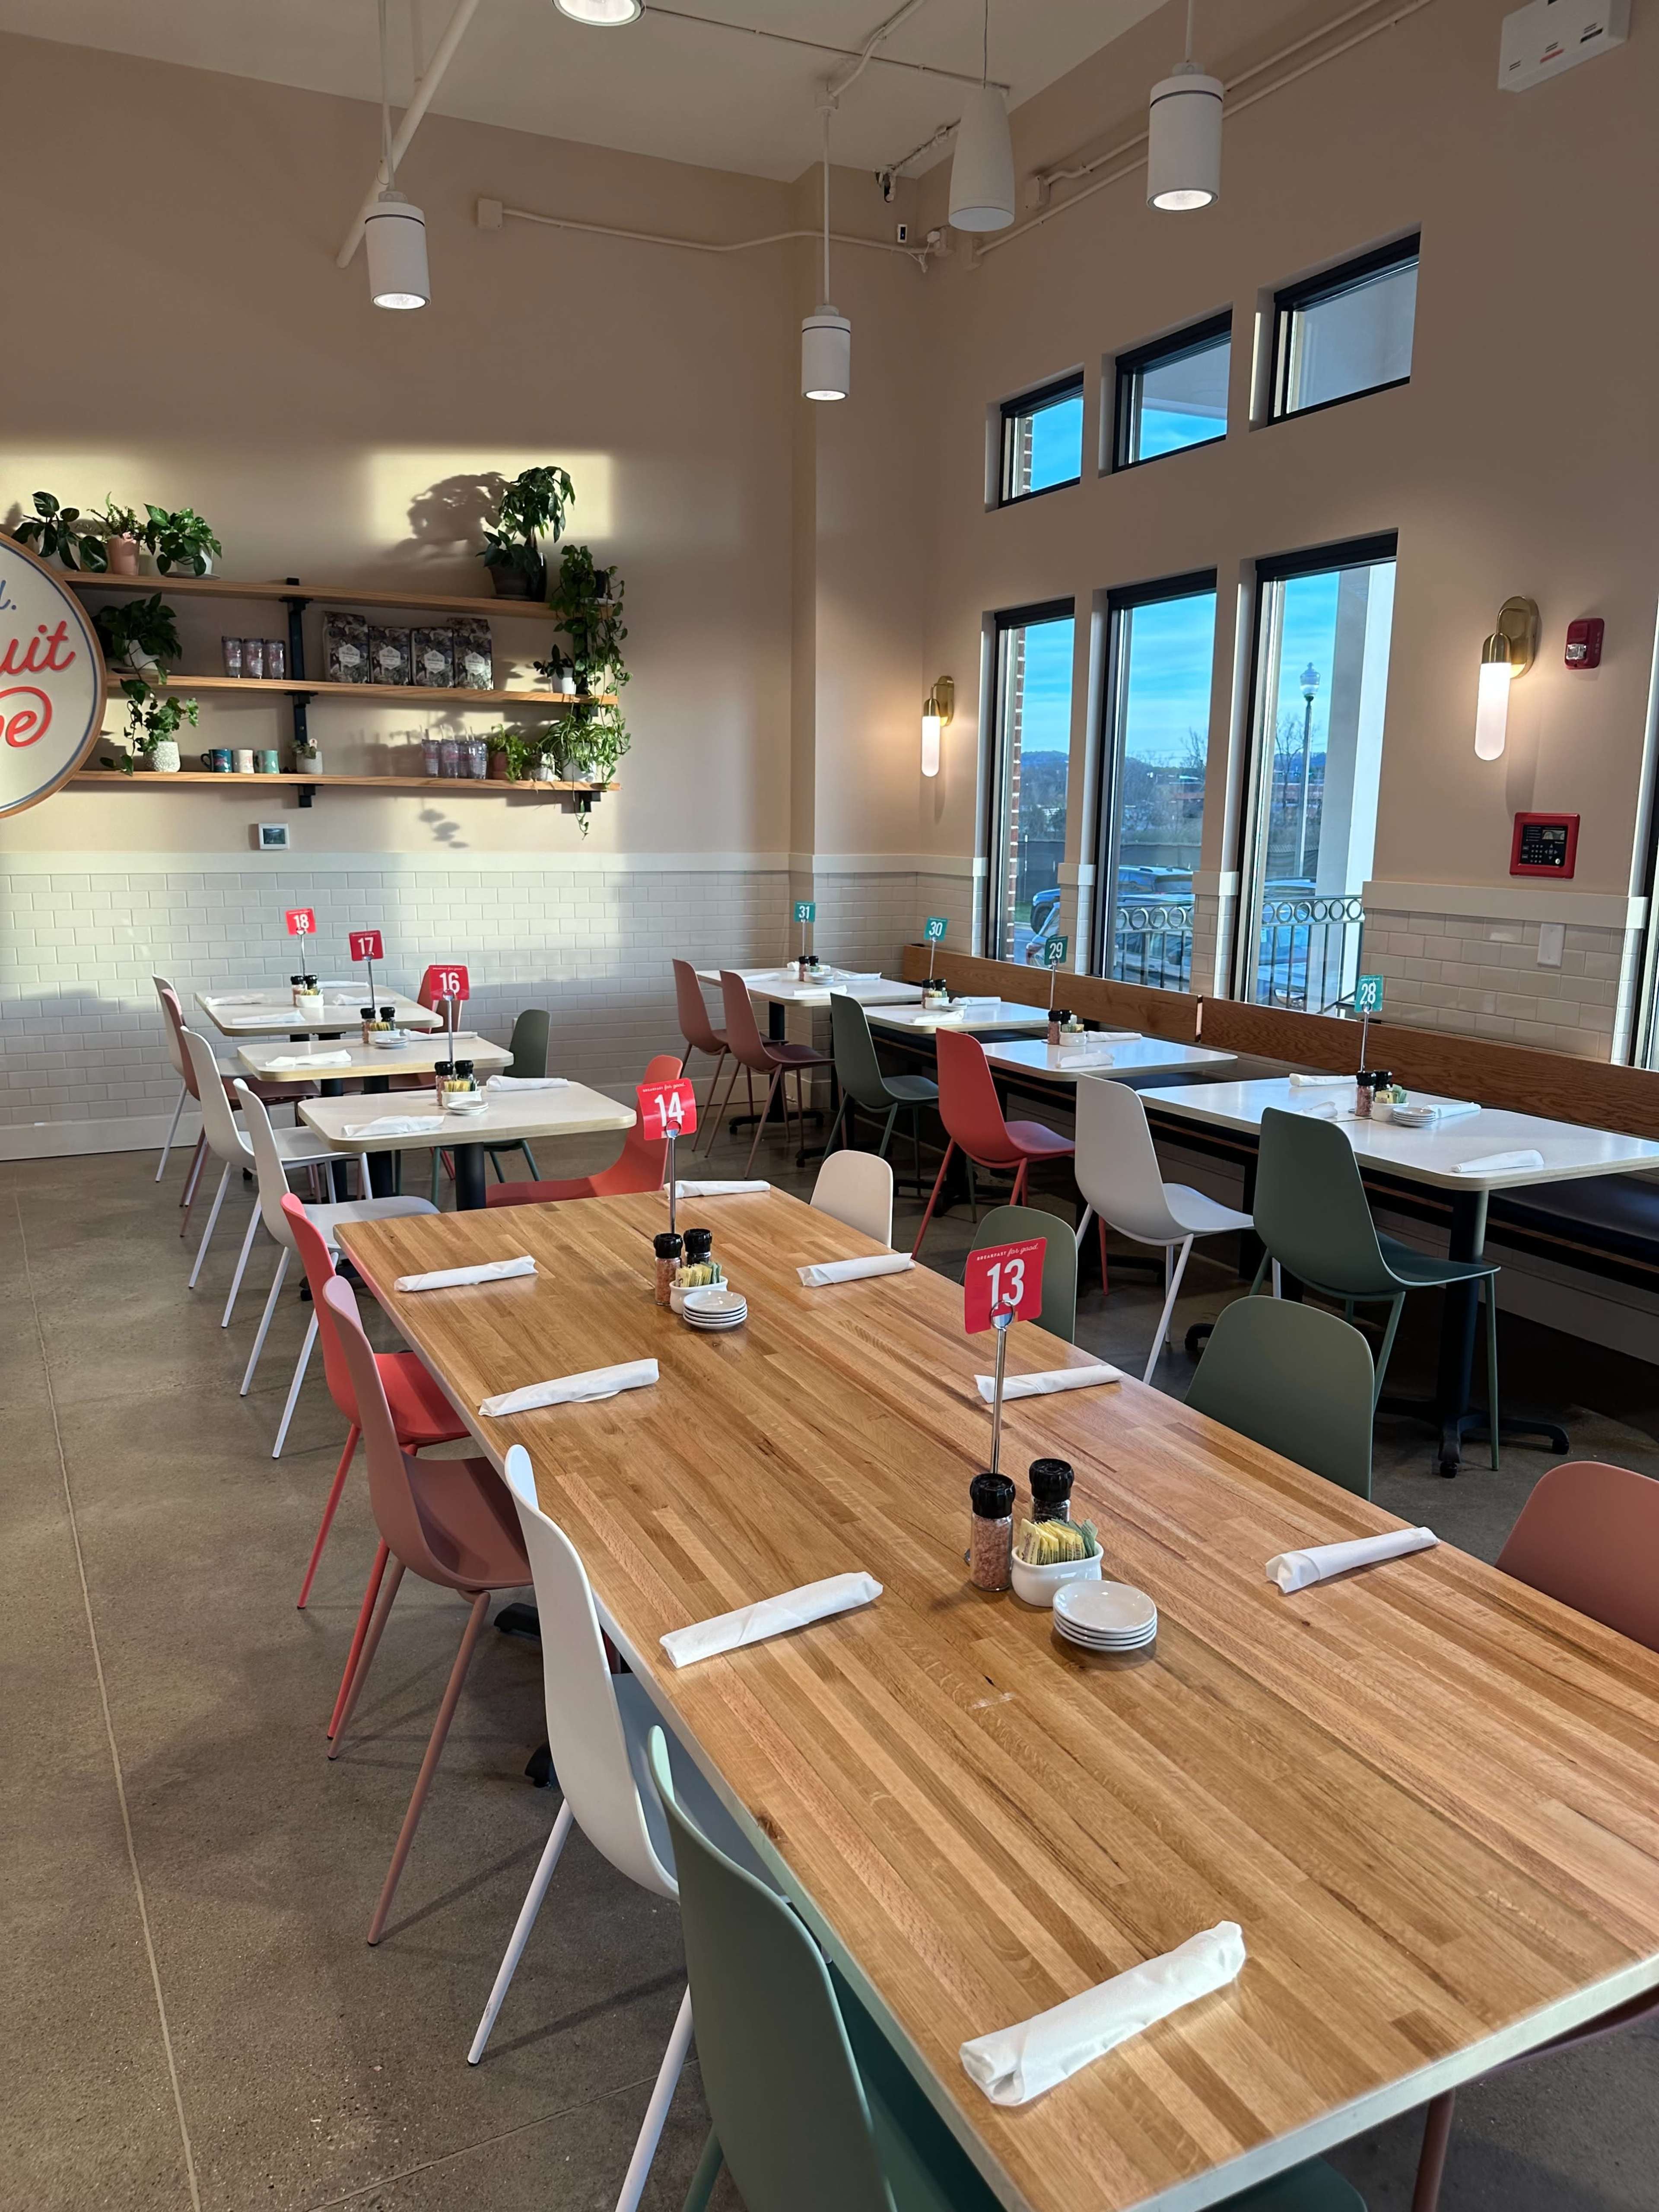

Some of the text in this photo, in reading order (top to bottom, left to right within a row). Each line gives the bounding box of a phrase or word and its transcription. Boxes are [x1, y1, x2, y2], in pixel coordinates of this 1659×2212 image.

[292, 913, 310, 929] 18
[798, 906, 810, 919] 31
[929, 921, 943, 937] 30
[358, 937, 374, 955] 17
[1049, 942, 1063, 959] 29
[439, 972, 460, 994] 16
[1360, 982, 1376, 1005] 28
[654, 1092, 685, 1127] 14
[976, 1251, 1007, 1261] BREAKFAST
[1007, 1248, 1020, 1257] for
[987, 1259, 1025, 1309] 13
